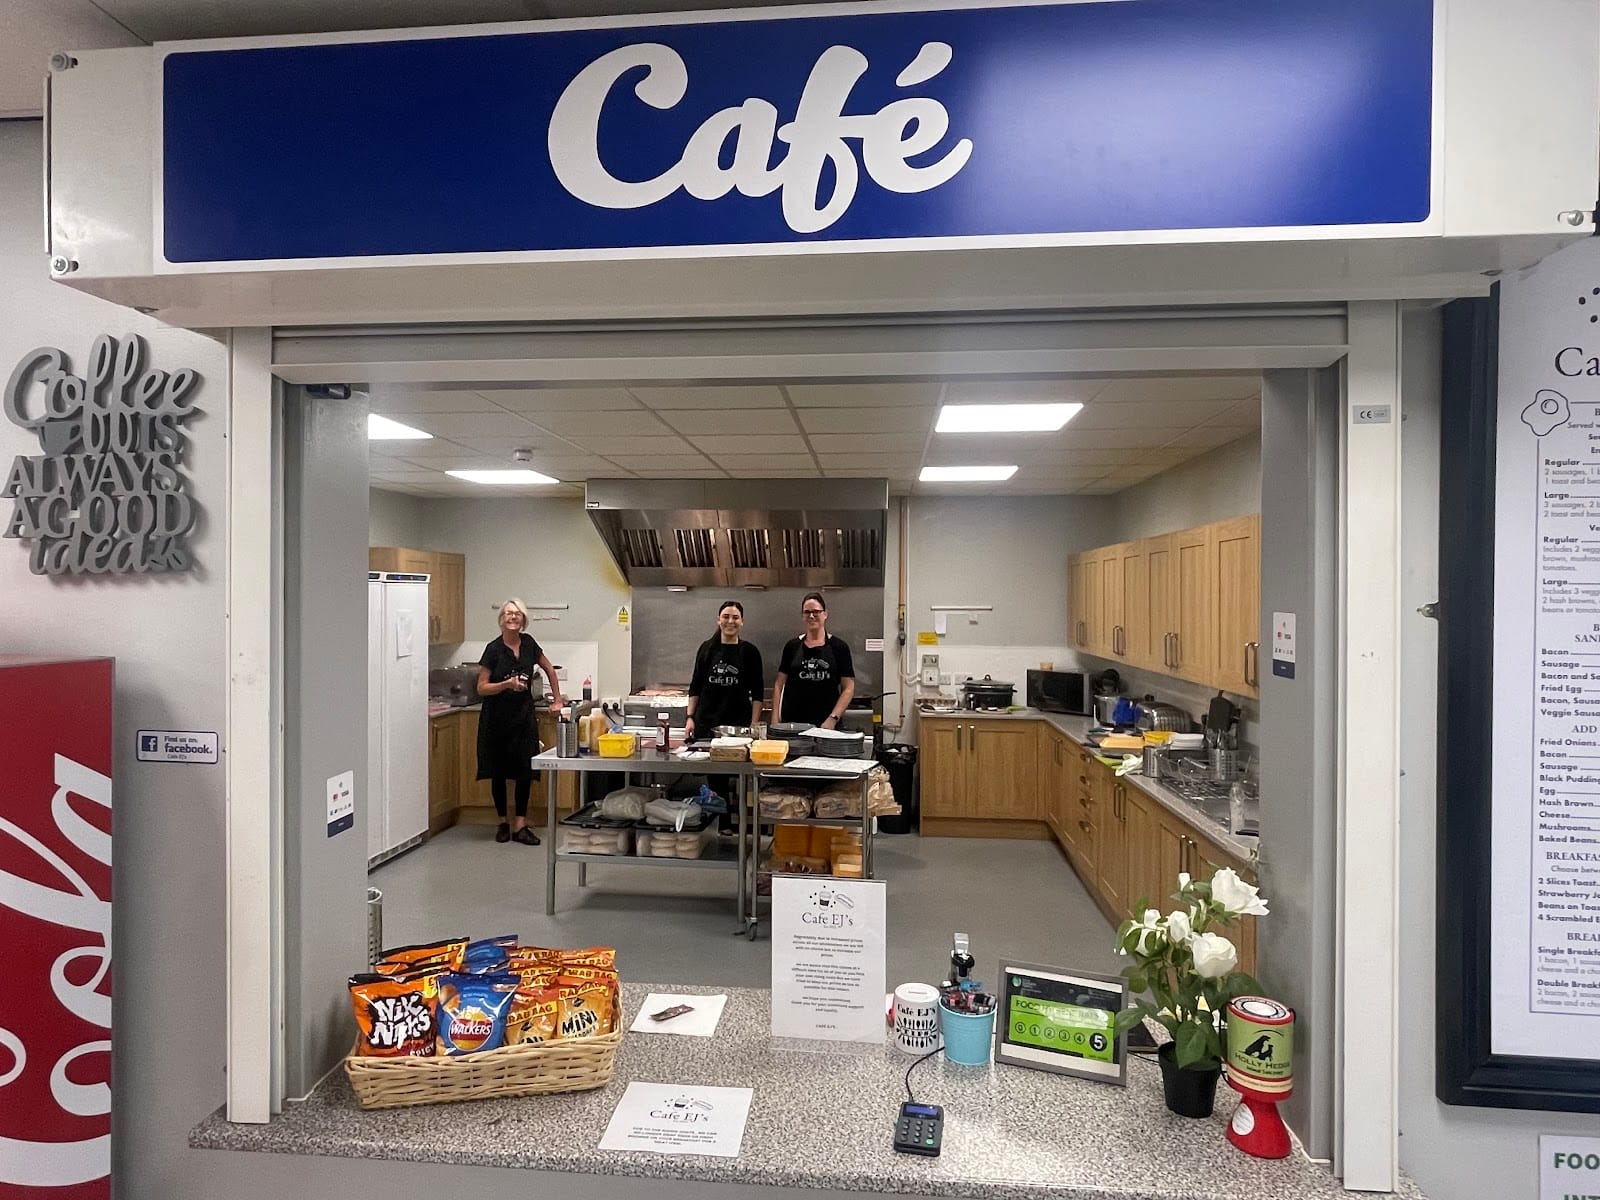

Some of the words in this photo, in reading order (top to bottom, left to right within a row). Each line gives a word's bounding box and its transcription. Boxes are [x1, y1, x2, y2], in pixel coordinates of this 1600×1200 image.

[548, 42, 974, 233] Café
[3, 333, 199, 452] Coffee
[138, 414, 178, 452] IS
[1544, 458, 1580, 467] Regular
[0, 453, 179, 498] ALWAYS
[1544, 491, 1570, 501] Large
[2, 496, 39, 538] A
[38, 492, 192, 538] GOOD
[1543, 536, 1579, 544] Regular
[1543, 578, 1568, 587] Large
[1541, 661, 1580, 670] Sausage
[708, 675, 723, 684] Cafe
[799, 671, 816, 680] Cafe
[1541, 684, 1563, 692] Fried
[1565, 685, 1582, 694] Egg
[1541, 697, 1571, 705] Bacon,
[1540, 708, 1572, 718] Veggie
[1571, 725, 1597, 733] ADD
[164, 735, 178, 743] Find
[1540, 738, 1563, 746] Fried
[1565, 738, 1597, 747] Onions
[1540, 763, 1578, 772] Sausage
[1539, 787, 1556, 796] Egg
[1539, 799, 1562, 807] Hash
[1539, 811, 1570, 819] Cheese
[1539, 823, 1591, 831] Mushrooms
[1539, 835, 1567, 843] Baked
[1569, 836, 1597, 844] Beans
[1546, 877, 1570, 885] Slices
[1538, 889, 1590, 900] Strawberry
[1538, 901, 1565, 909] Beans
[801, 911, 829, 925] Cafe
[832, 913, 854, 928] EJ's
[1546, 914, 1593, 923] Scrambled
[1537, 946, 1565, 955] Single
[1537, 979, 1569, 987] Double
[450, 1021, 492, 1036] WALKERS
[1093, 1034, 1103, 1050] 5
[1235, 1052, 1262, 1067] HOLLY
[649, 1109, 680, 1120] Cafe
[683, 1112, 709, 1122] EJ's
[1554, 1152, 1600, 1170] FOO
